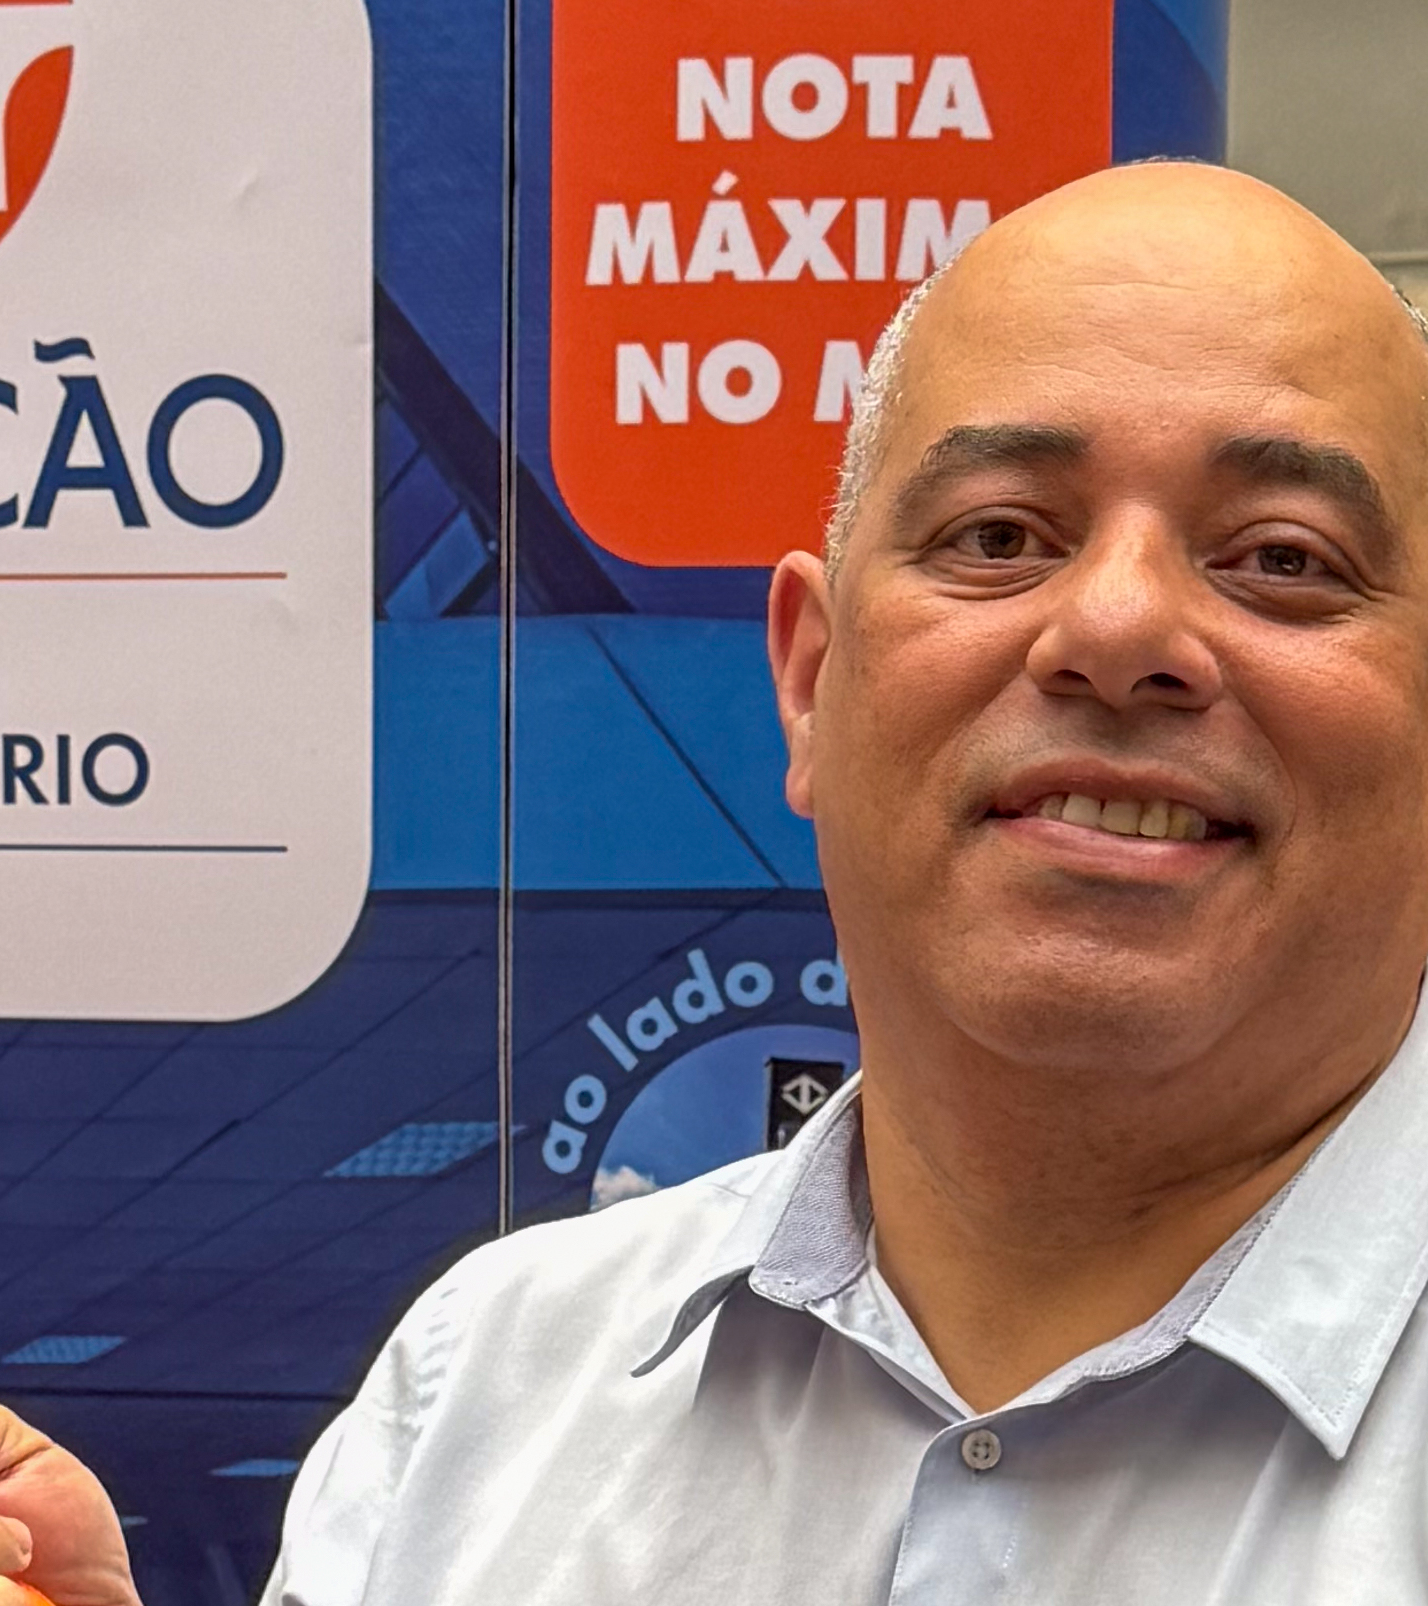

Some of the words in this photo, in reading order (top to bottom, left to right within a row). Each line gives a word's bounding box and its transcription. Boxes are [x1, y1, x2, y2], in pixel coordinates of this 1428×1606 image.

[677, 54, 992, 142] NOTA
[585, 171, 992, 285] MÁXIM
[616, 340, 782, 425] NO
[542, 1074, 607, 1174] ao
[587, 948, 774, 1072] lado
